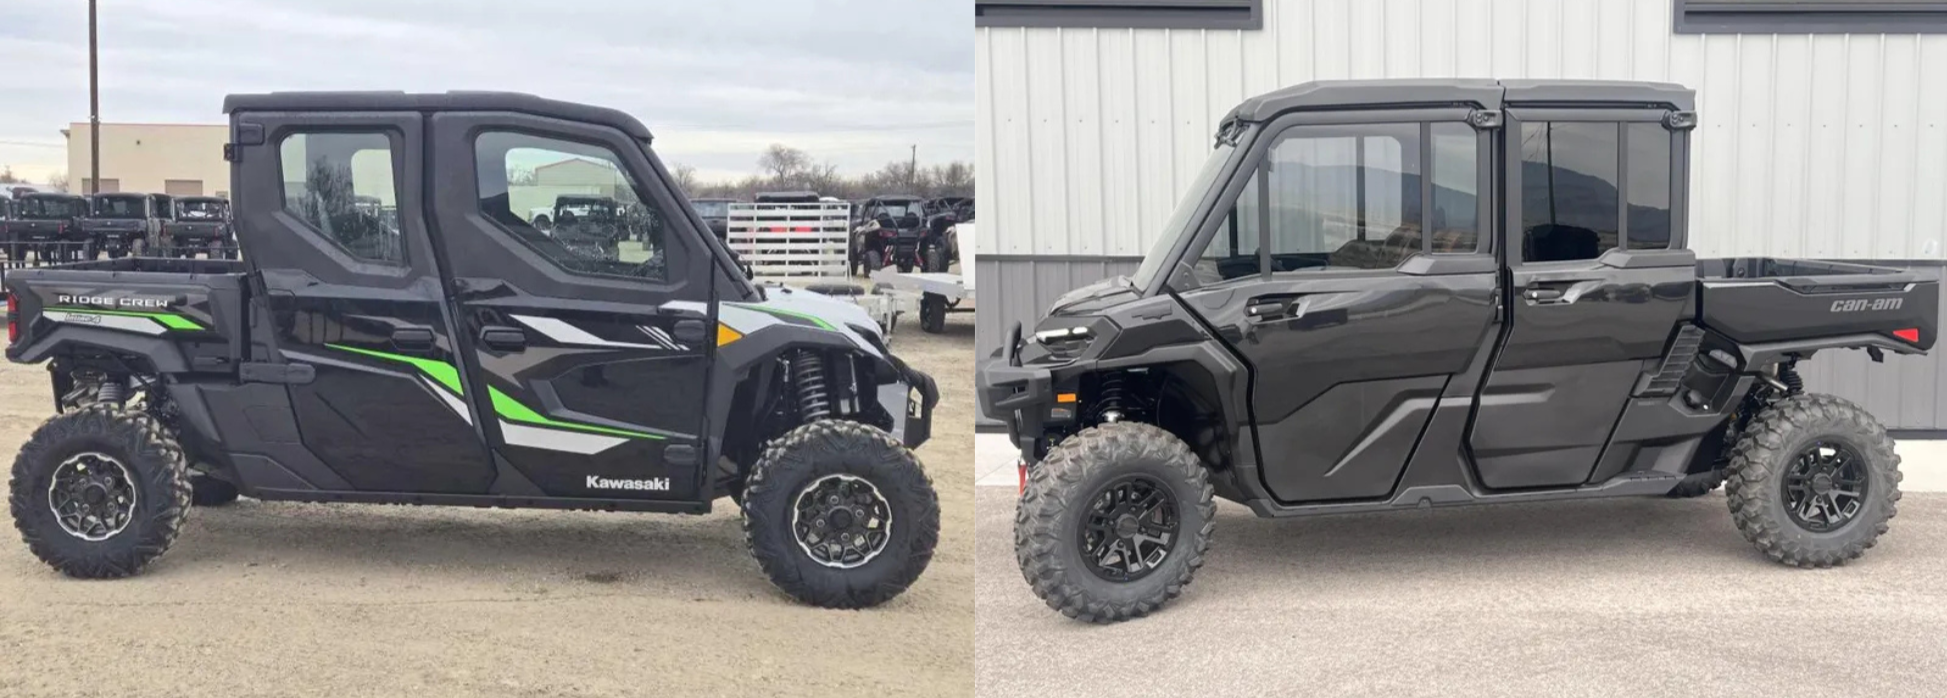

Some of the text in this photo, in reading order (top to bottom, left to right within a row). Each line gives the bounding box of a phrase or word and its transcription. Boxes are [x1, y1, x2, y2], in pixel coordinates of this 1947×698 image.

[58, 294, 168, 308] RIDGE CREW
[1830, 297, 1904, 313] can-am
[585, 474, 670, 491] Kawasaki
